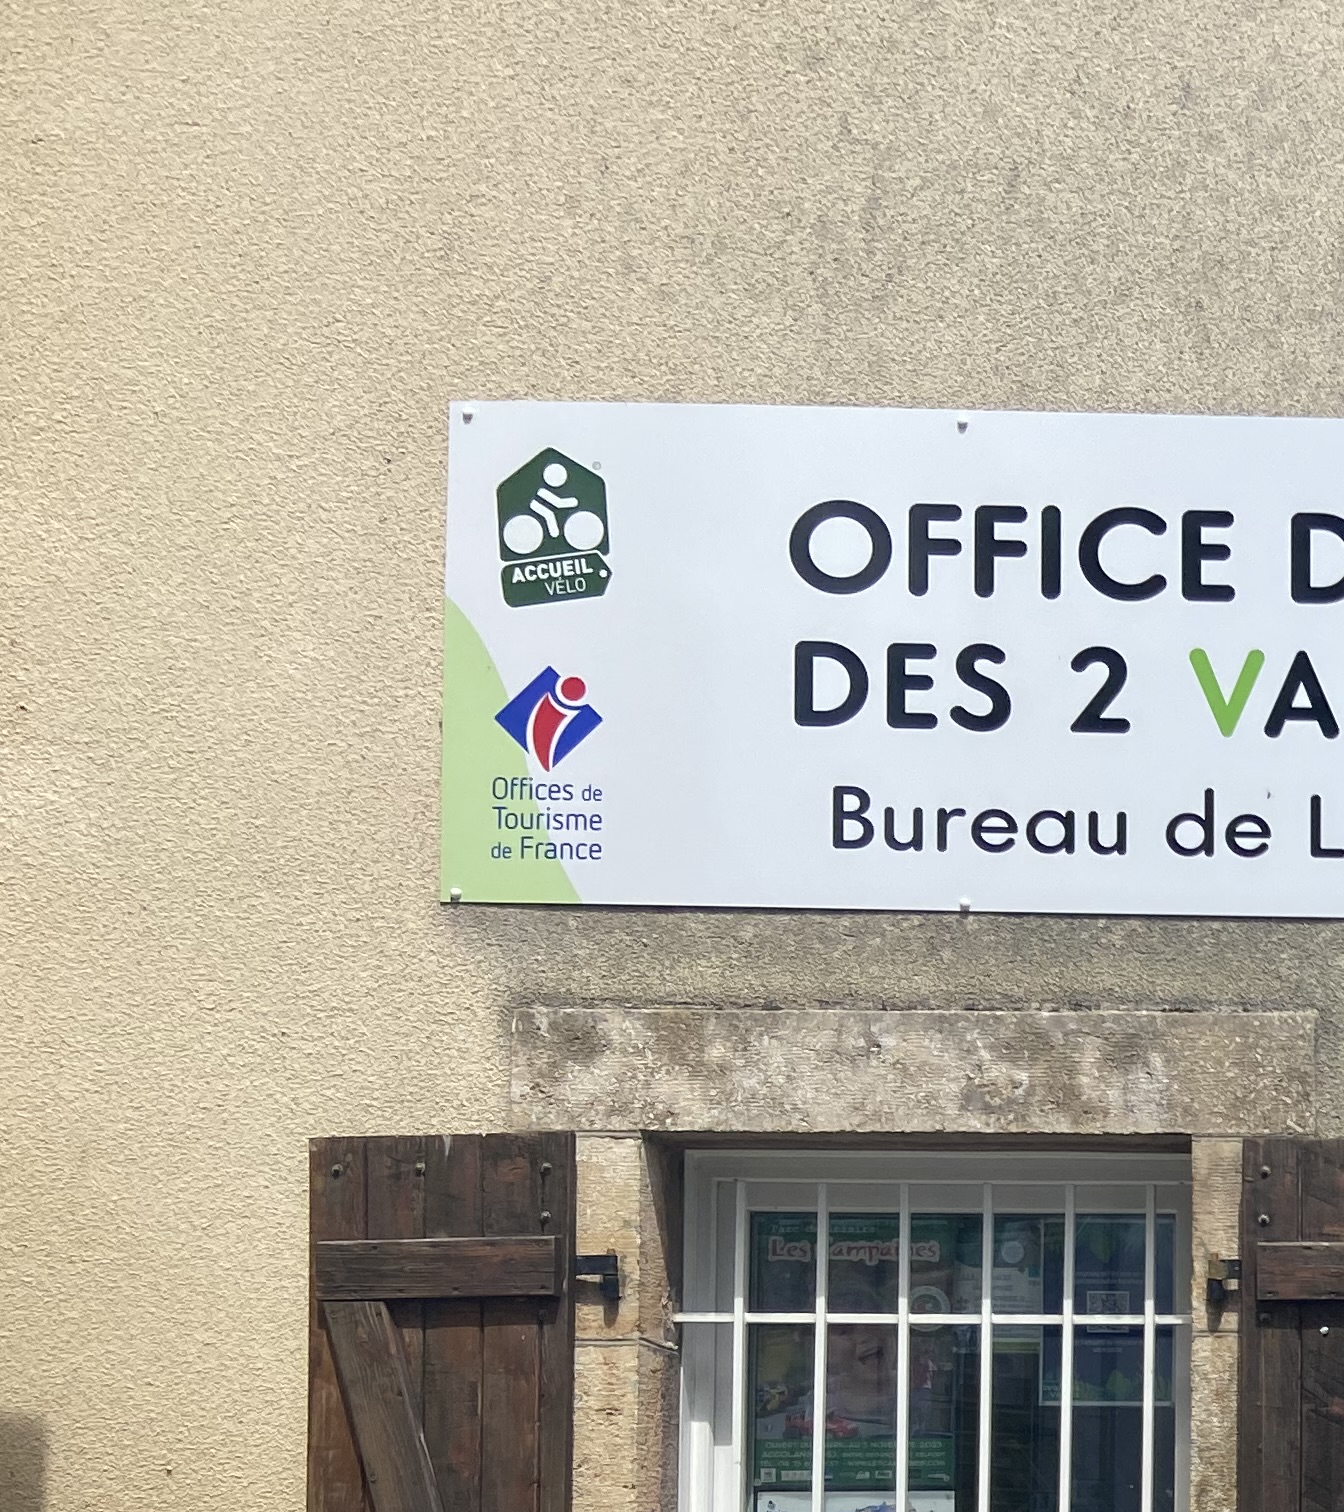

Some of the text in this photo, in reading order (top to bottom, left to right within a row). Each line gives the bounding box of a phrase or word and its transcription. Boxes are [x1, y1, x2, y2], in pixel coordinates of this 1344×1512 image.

[789, 499, 1236, 602] OFFICE
[512, 558, 594, 583] ACCUEIL
[544, 577, 587, 596] VÉLO
[794, 640, 1012, 732] DES
[1070, 646, 1131, 733] 2
[492, 776, 603, 802] Offices de
[491, 806, 603, 831] Tourisme
[832, 785, 1127, 856] Bureau
[1165, 787, 1272, 858] de
[491, 836, 602, 860] de France
[770, 1238, 809, 1258] Les
